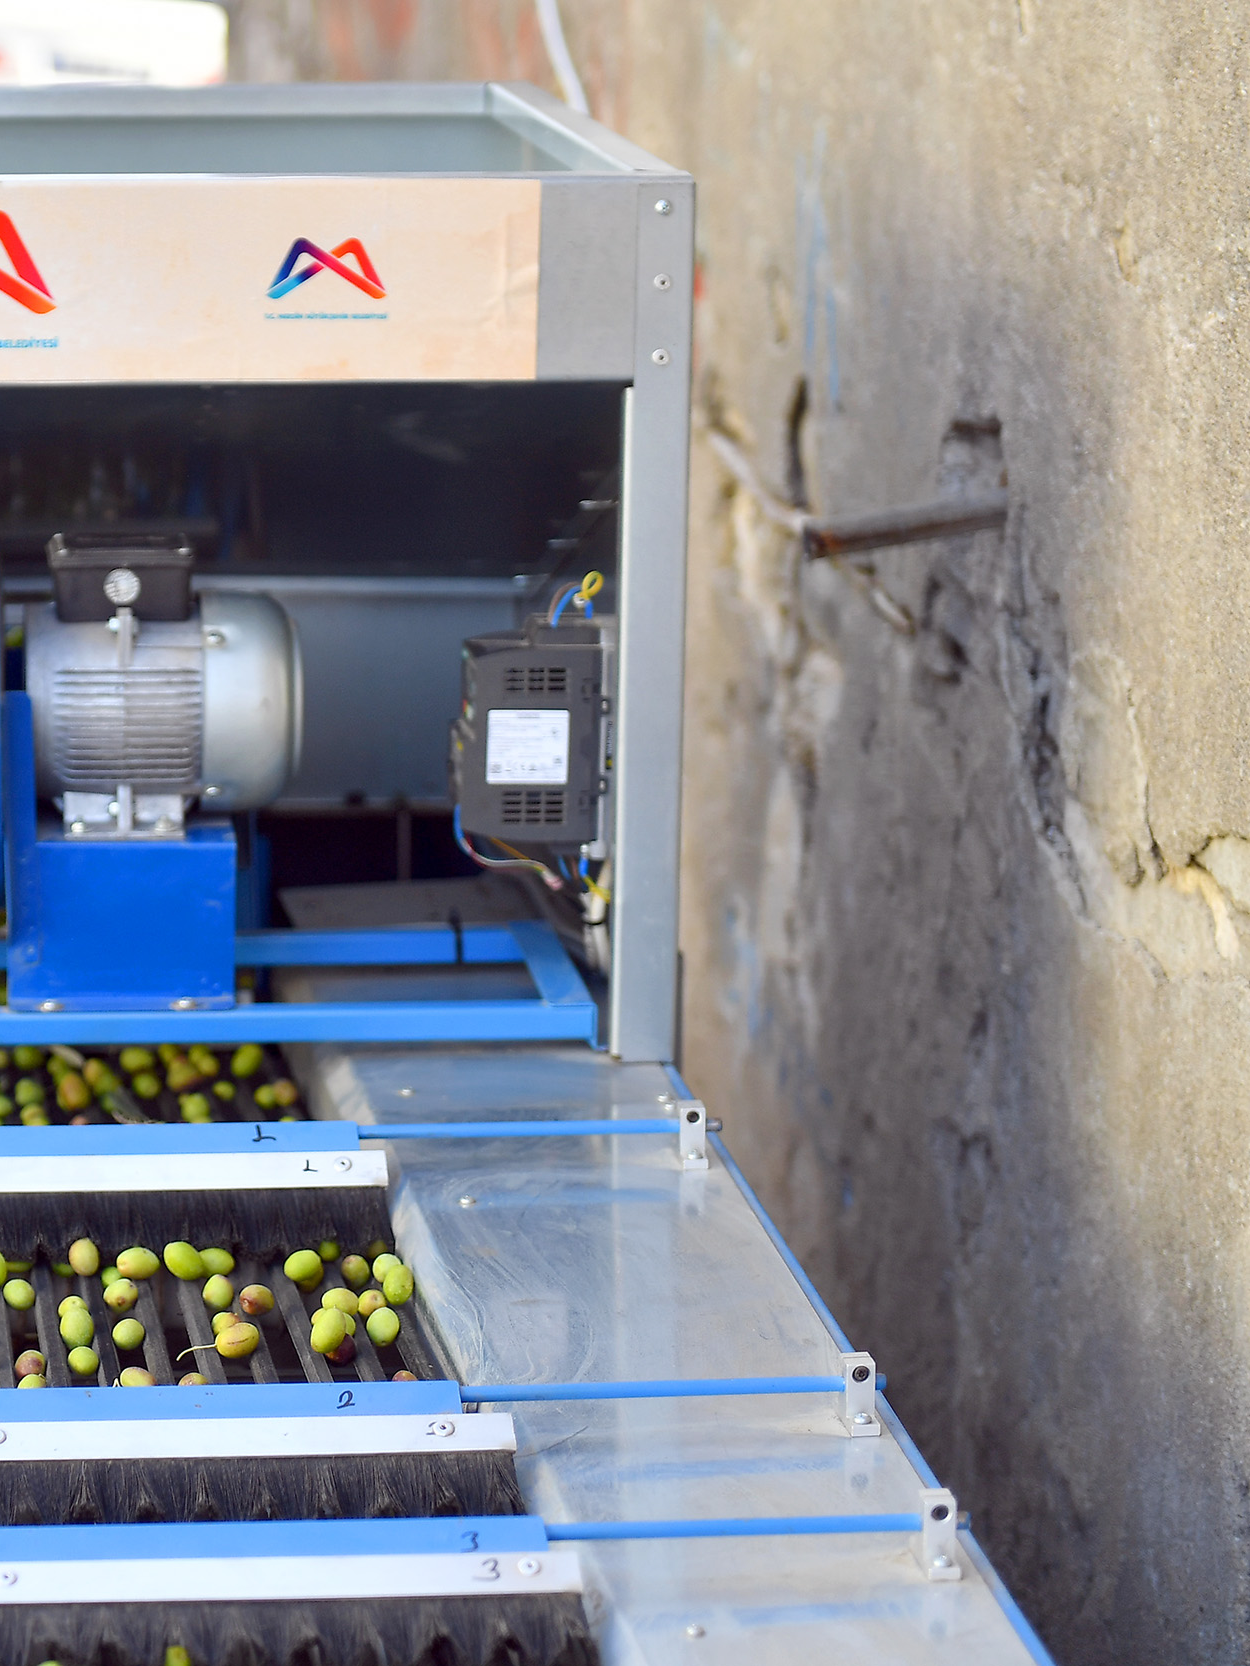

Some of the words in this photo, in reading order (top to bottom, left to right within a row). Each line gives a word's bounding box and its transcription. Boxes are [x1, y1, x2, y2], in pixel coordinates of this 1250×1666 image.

[337, 1390, 355, 1409] 2
[461, 1531, 479, 1553] 3
[472, 1558, 501, 1581] 3
